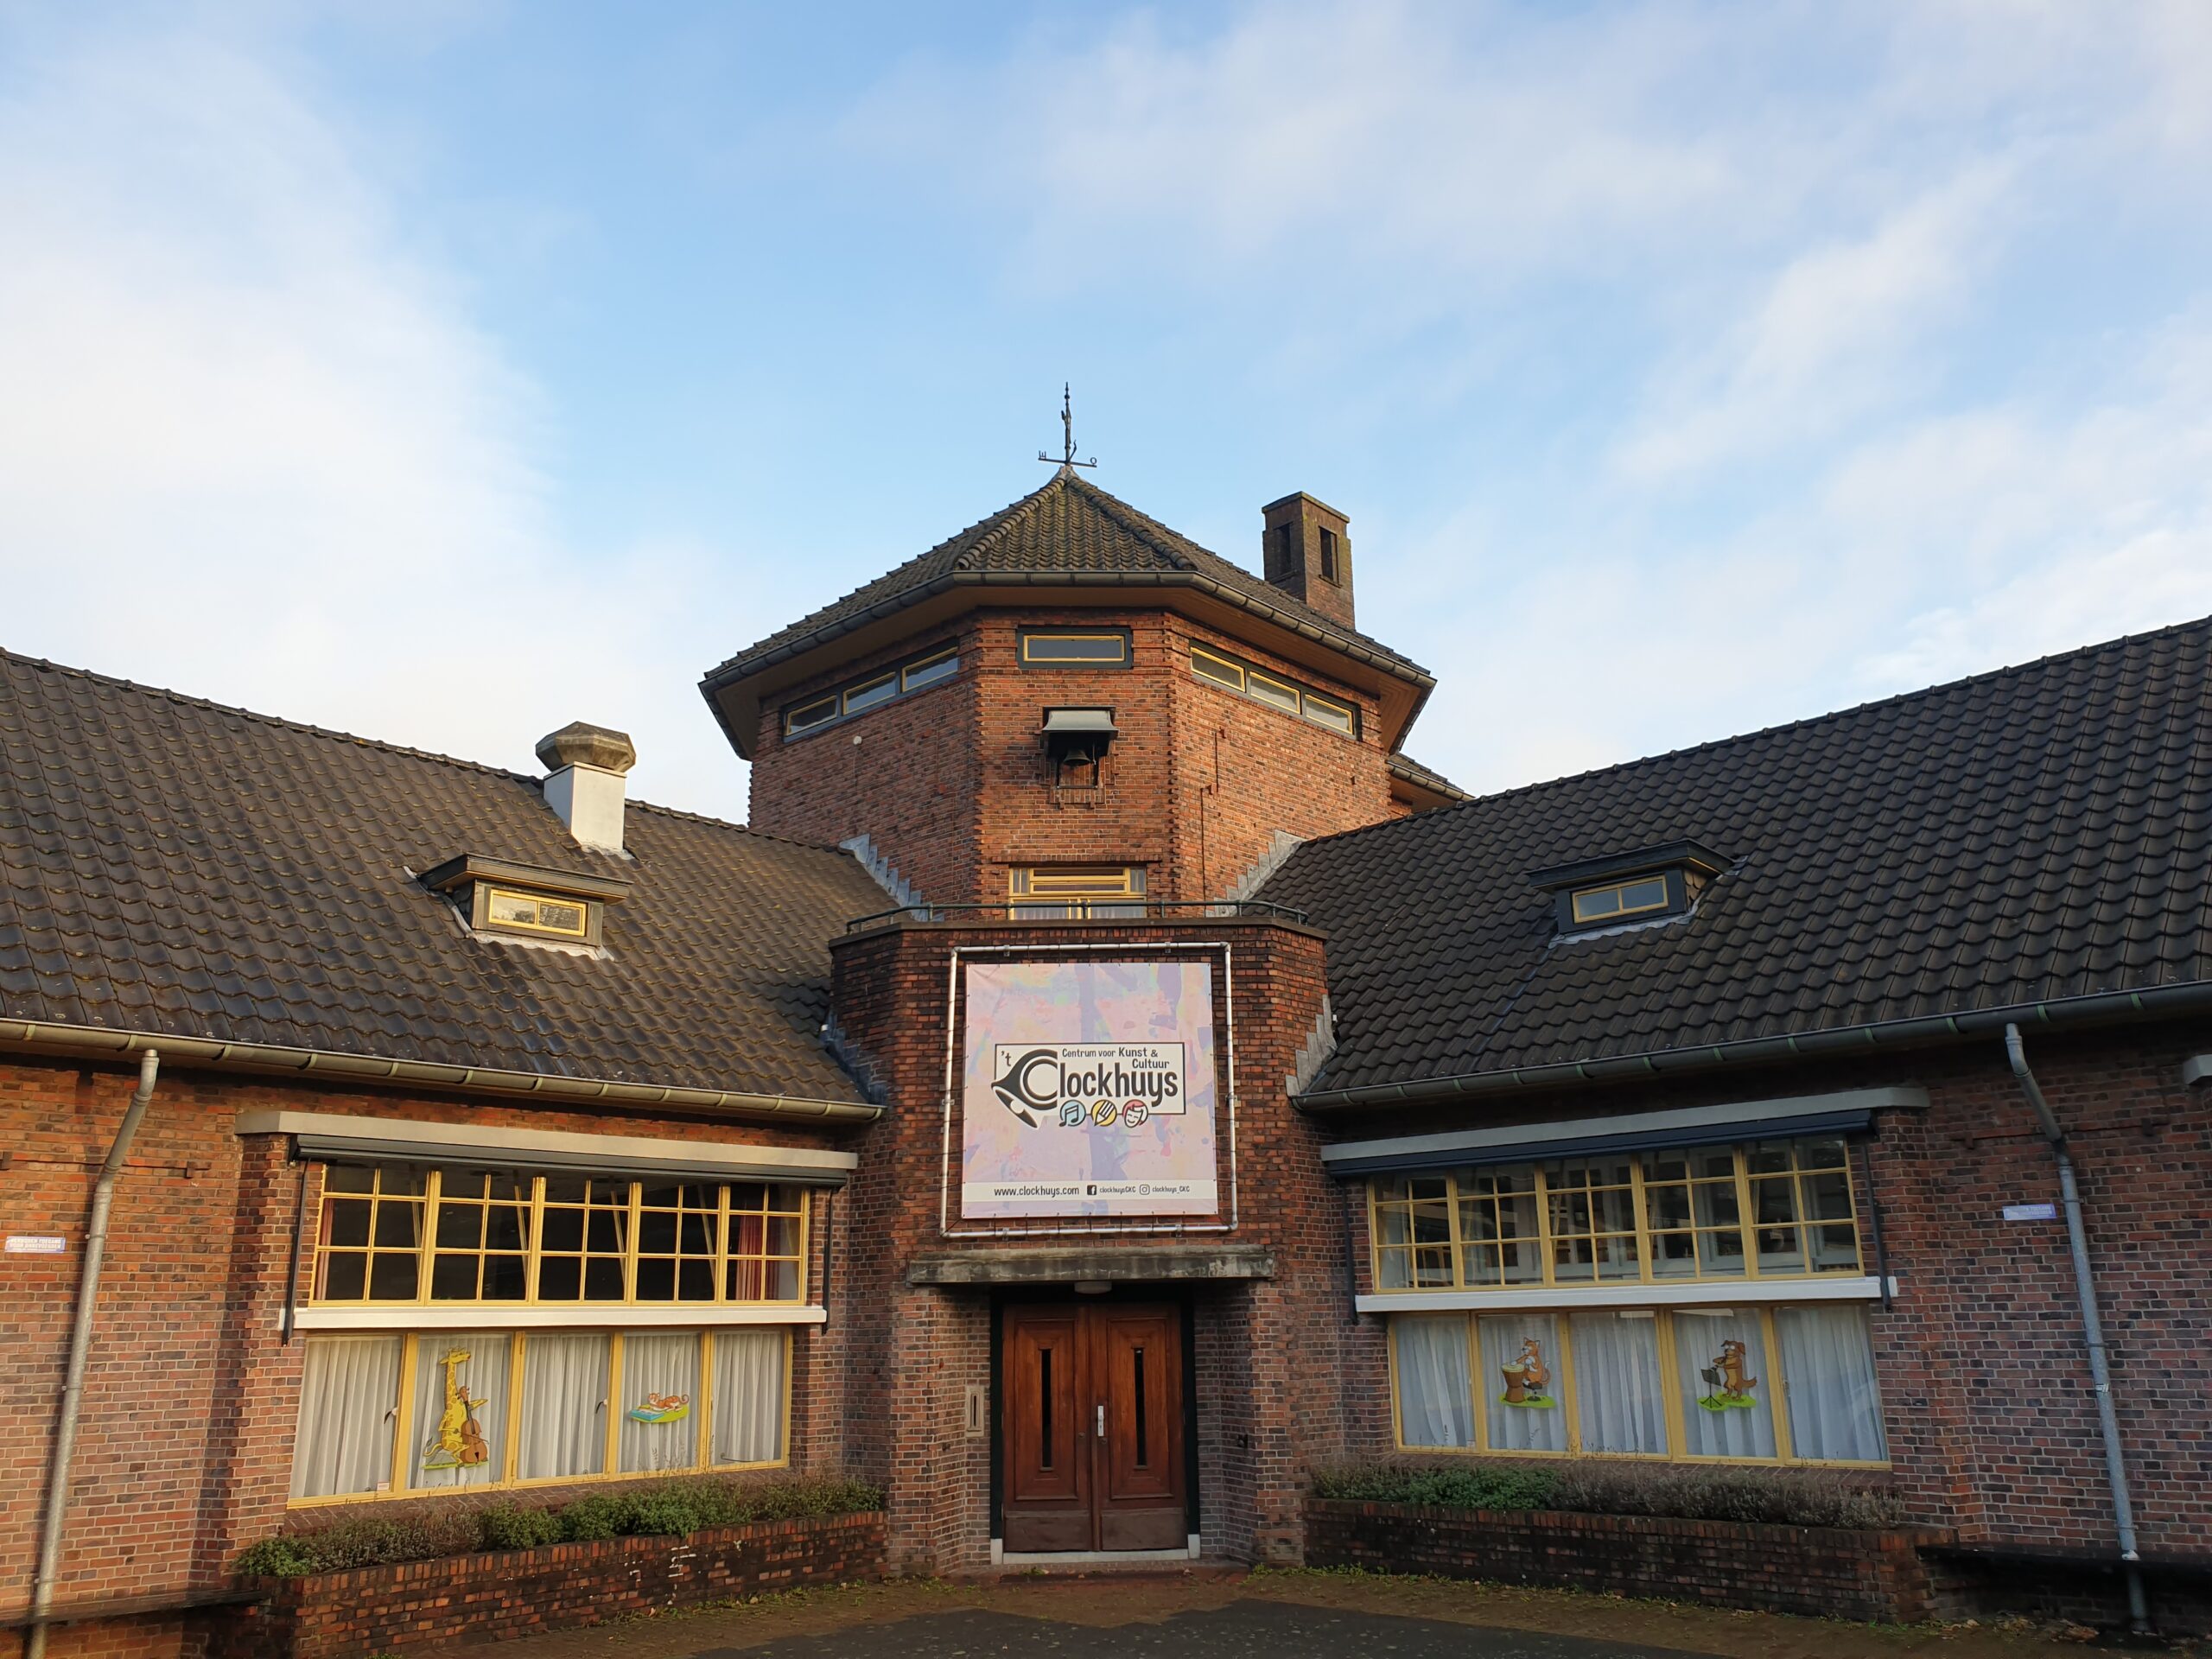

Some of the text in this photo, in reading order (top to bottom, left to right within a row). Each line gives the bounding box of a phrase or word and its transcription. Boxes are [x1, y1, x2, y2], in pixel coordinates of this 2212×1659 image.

[1062, 1048, 1096, 1058] Centrum
[1118, 1046, 1147, 1058] Kunst
[1151, 1049, 1158, 1058] &
[1132, 1058, 1170, 1069] Cultuur
[991, 1048, 1178, 1111] Clockhuys
[994, 1185, 1080, 1198] www.clockhuys.com
